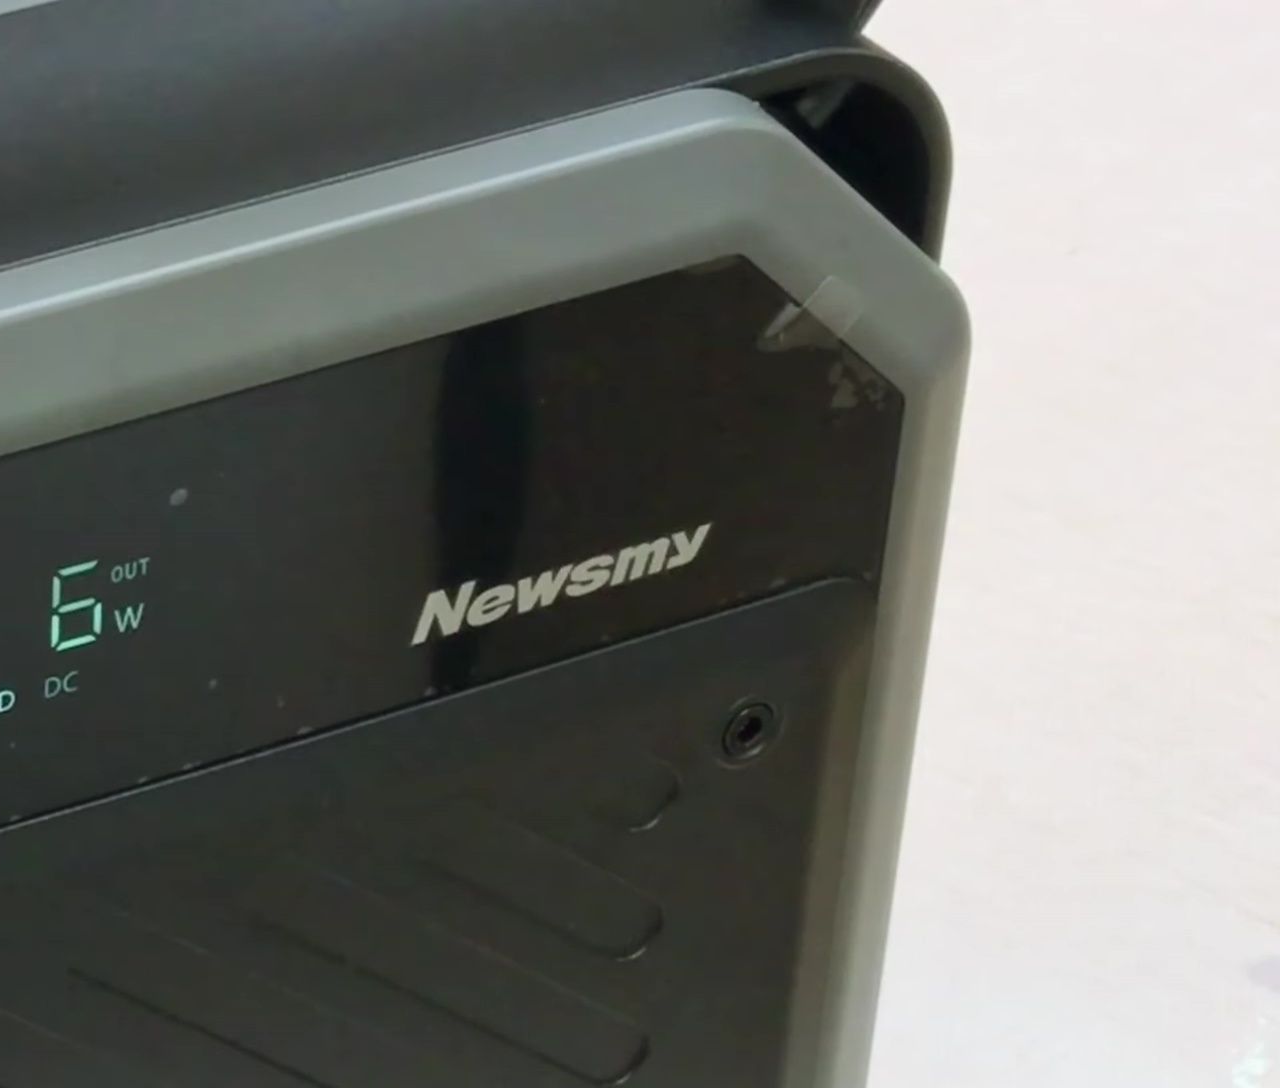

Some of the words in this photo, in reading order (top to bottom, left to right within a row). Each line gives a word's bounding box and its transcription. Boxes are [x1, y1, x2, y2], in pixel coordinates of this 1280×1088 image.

[110, 556, 151, 584] OUT
[410, 522, 713, 648] Newsmy
[50, 559, 103, 652] 6
[113, 602, 145, 634] W
[43, 670, 79, 699] DC
